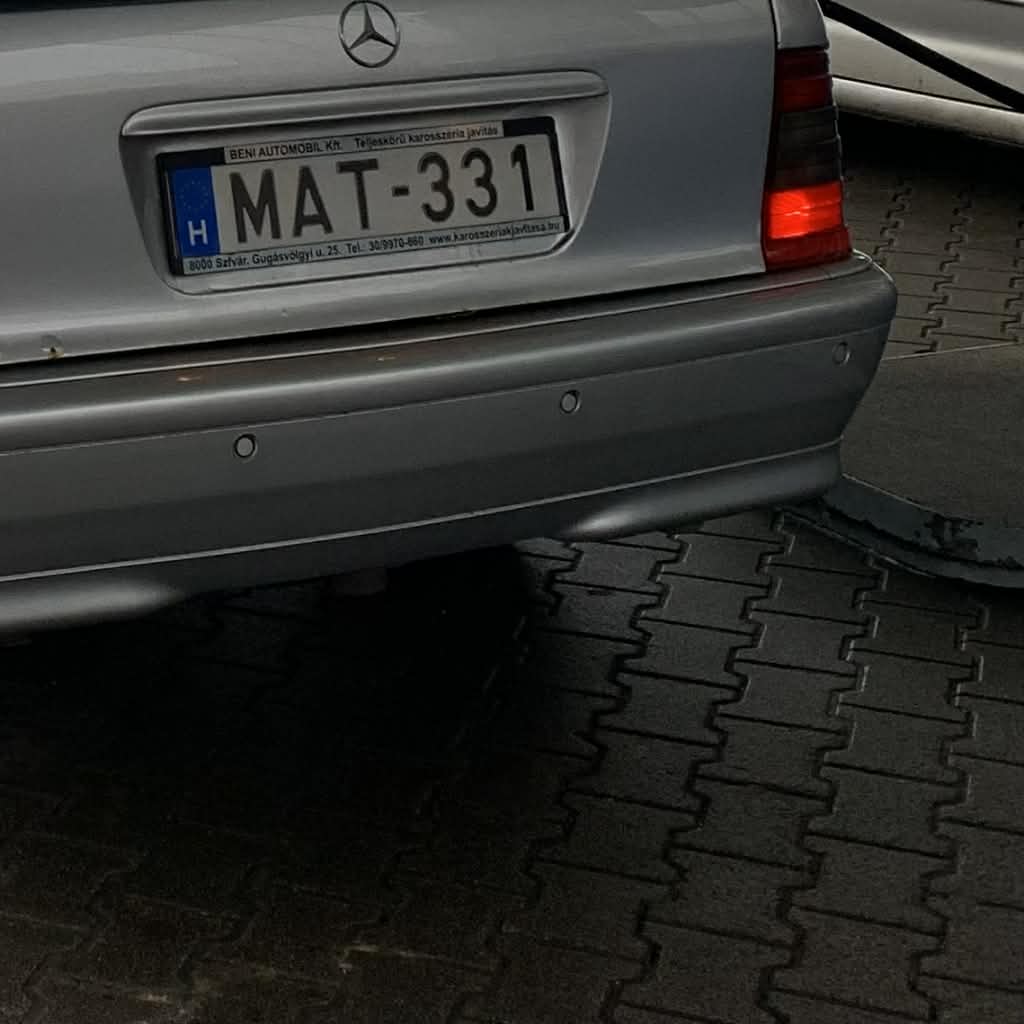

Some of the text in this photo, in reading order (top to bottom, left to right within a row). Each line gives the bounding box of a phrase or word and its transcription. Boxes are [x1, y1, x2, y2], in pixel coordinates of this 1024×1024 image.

[229, 148, 256, 160] BENI
[259, 143, 322, 156] AUTOMOBIL
[229, 143, 534, 243] MAT-331
[188, 219, 207, 246] H
[189, 259, 213, 271] 8000
